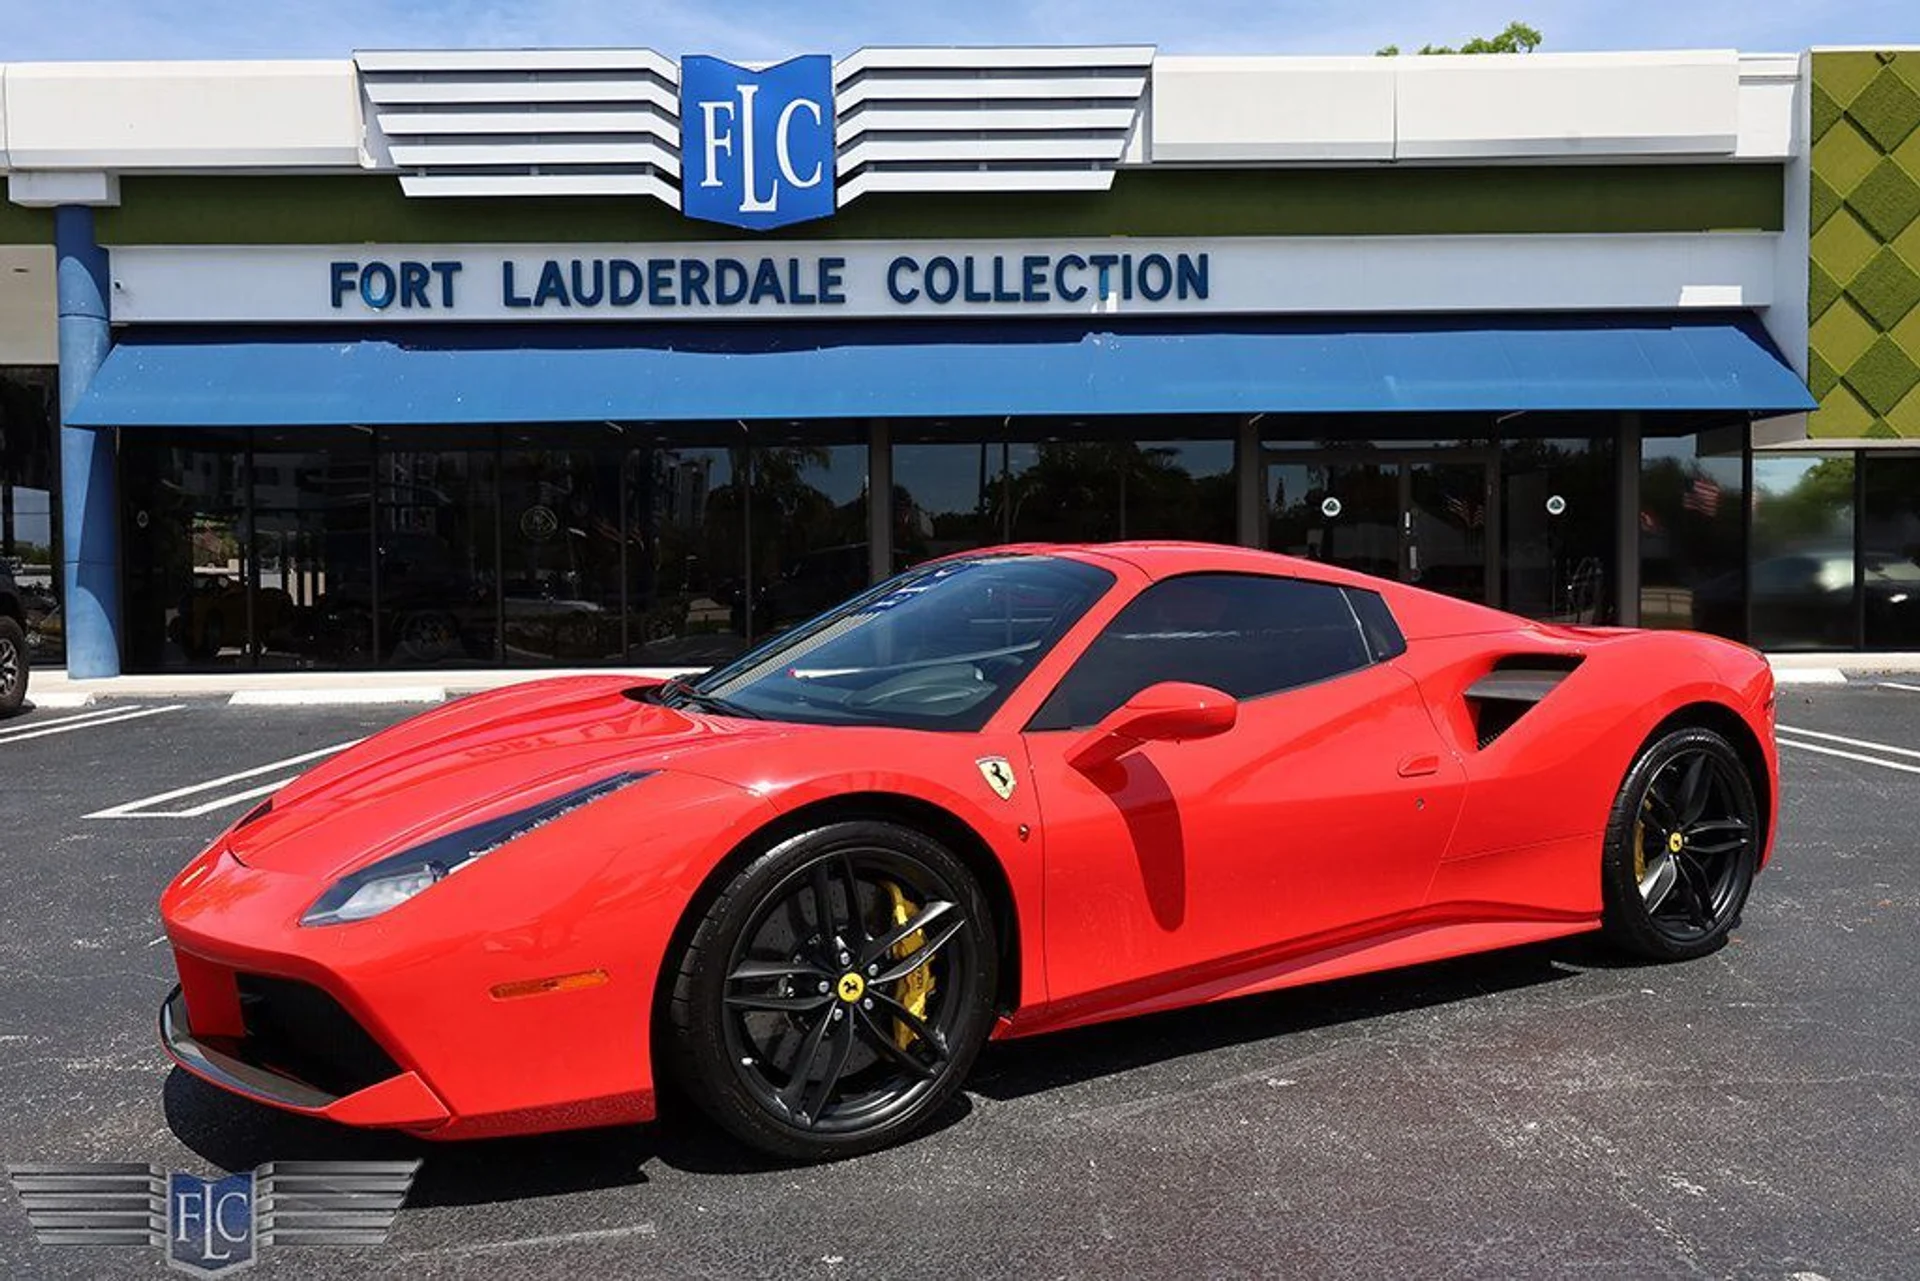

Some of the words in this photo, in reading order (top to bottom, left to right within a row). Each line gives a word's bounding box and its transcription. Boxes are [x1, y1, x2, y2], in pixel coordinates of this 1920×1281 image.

[699, 84, 822, 212] FLC
[330, 260, 462, 309] FORT
[502, 257, 846, 307] LAUDERDALE
[887, 253, 1209, 304] COLLECTION
